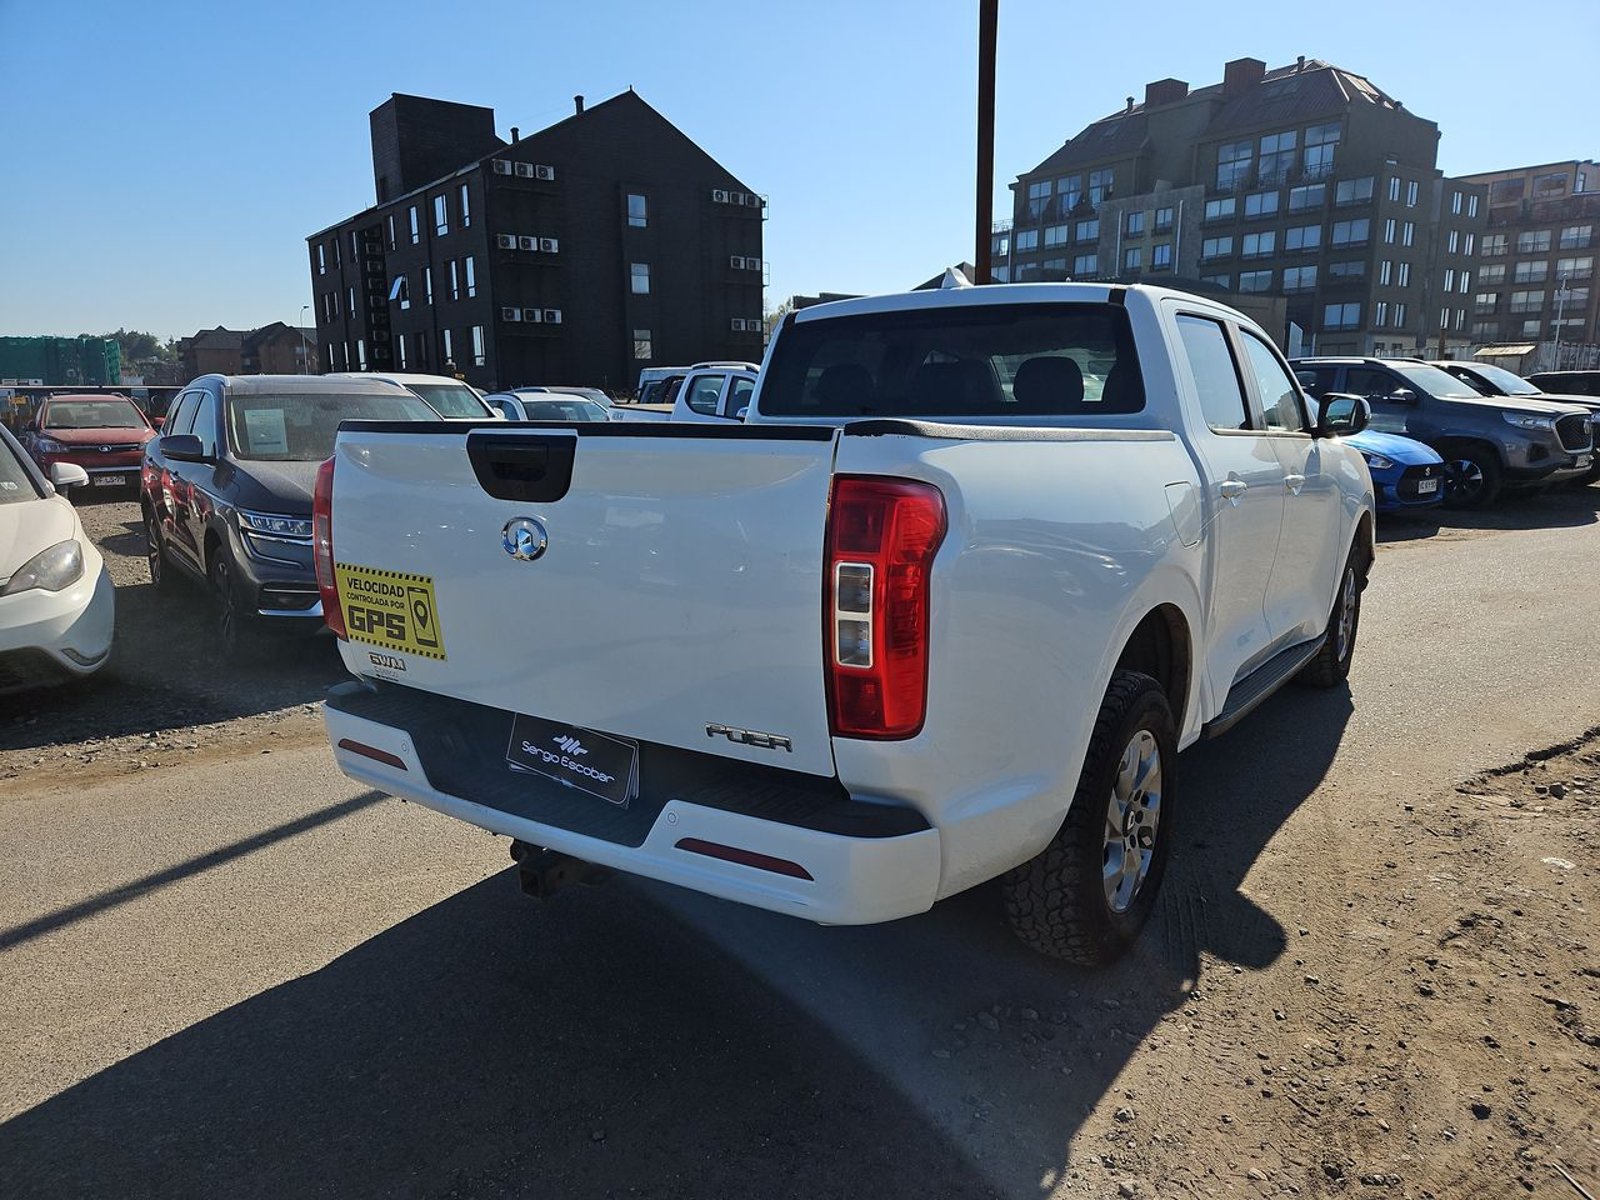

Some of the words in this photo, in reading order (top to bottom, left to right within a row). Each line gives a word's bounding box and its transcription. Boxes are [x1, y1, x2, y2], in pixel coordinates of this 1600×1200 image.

[346, 577, 405, 598] VELOCIDAD
[346, 592, 390, 607] CONTROLADA
[390, 600, 406, 610] POR
[347, 605, 406, 641] GPS
[704, 721, 793, 753] POER
[521, 740, 560, 764] Sergo
[560, 755, 615, 783] Escobar
